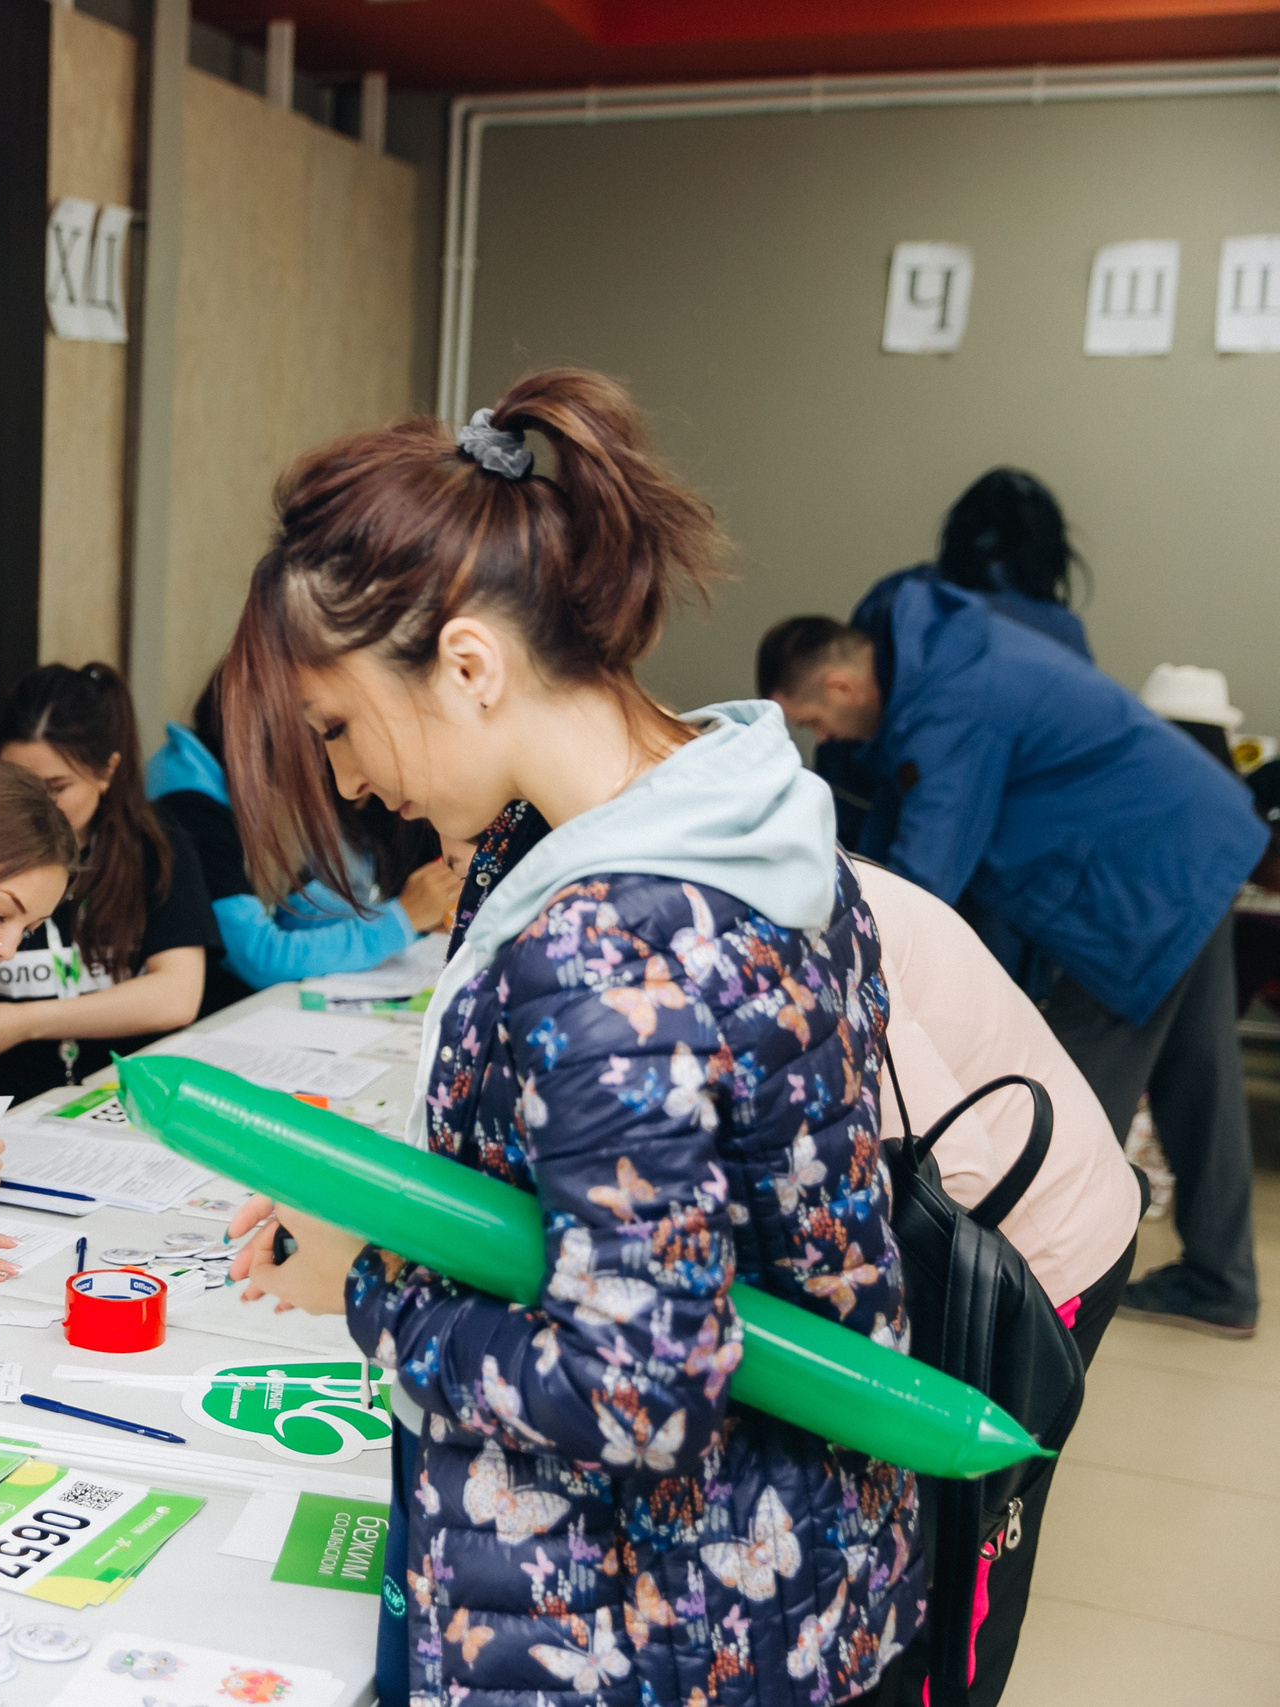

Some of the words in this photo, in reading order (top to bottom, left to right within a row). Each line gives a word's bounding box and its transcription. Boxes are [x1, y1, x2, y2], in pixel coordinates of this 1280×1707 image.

[906, 264, 955, 332] Ч
[333, 1512, 351, 1528] СО
[340, 1515, 389, 1580] бежим
[318, 1527, 347, 1576] СМЫСЛОМ
